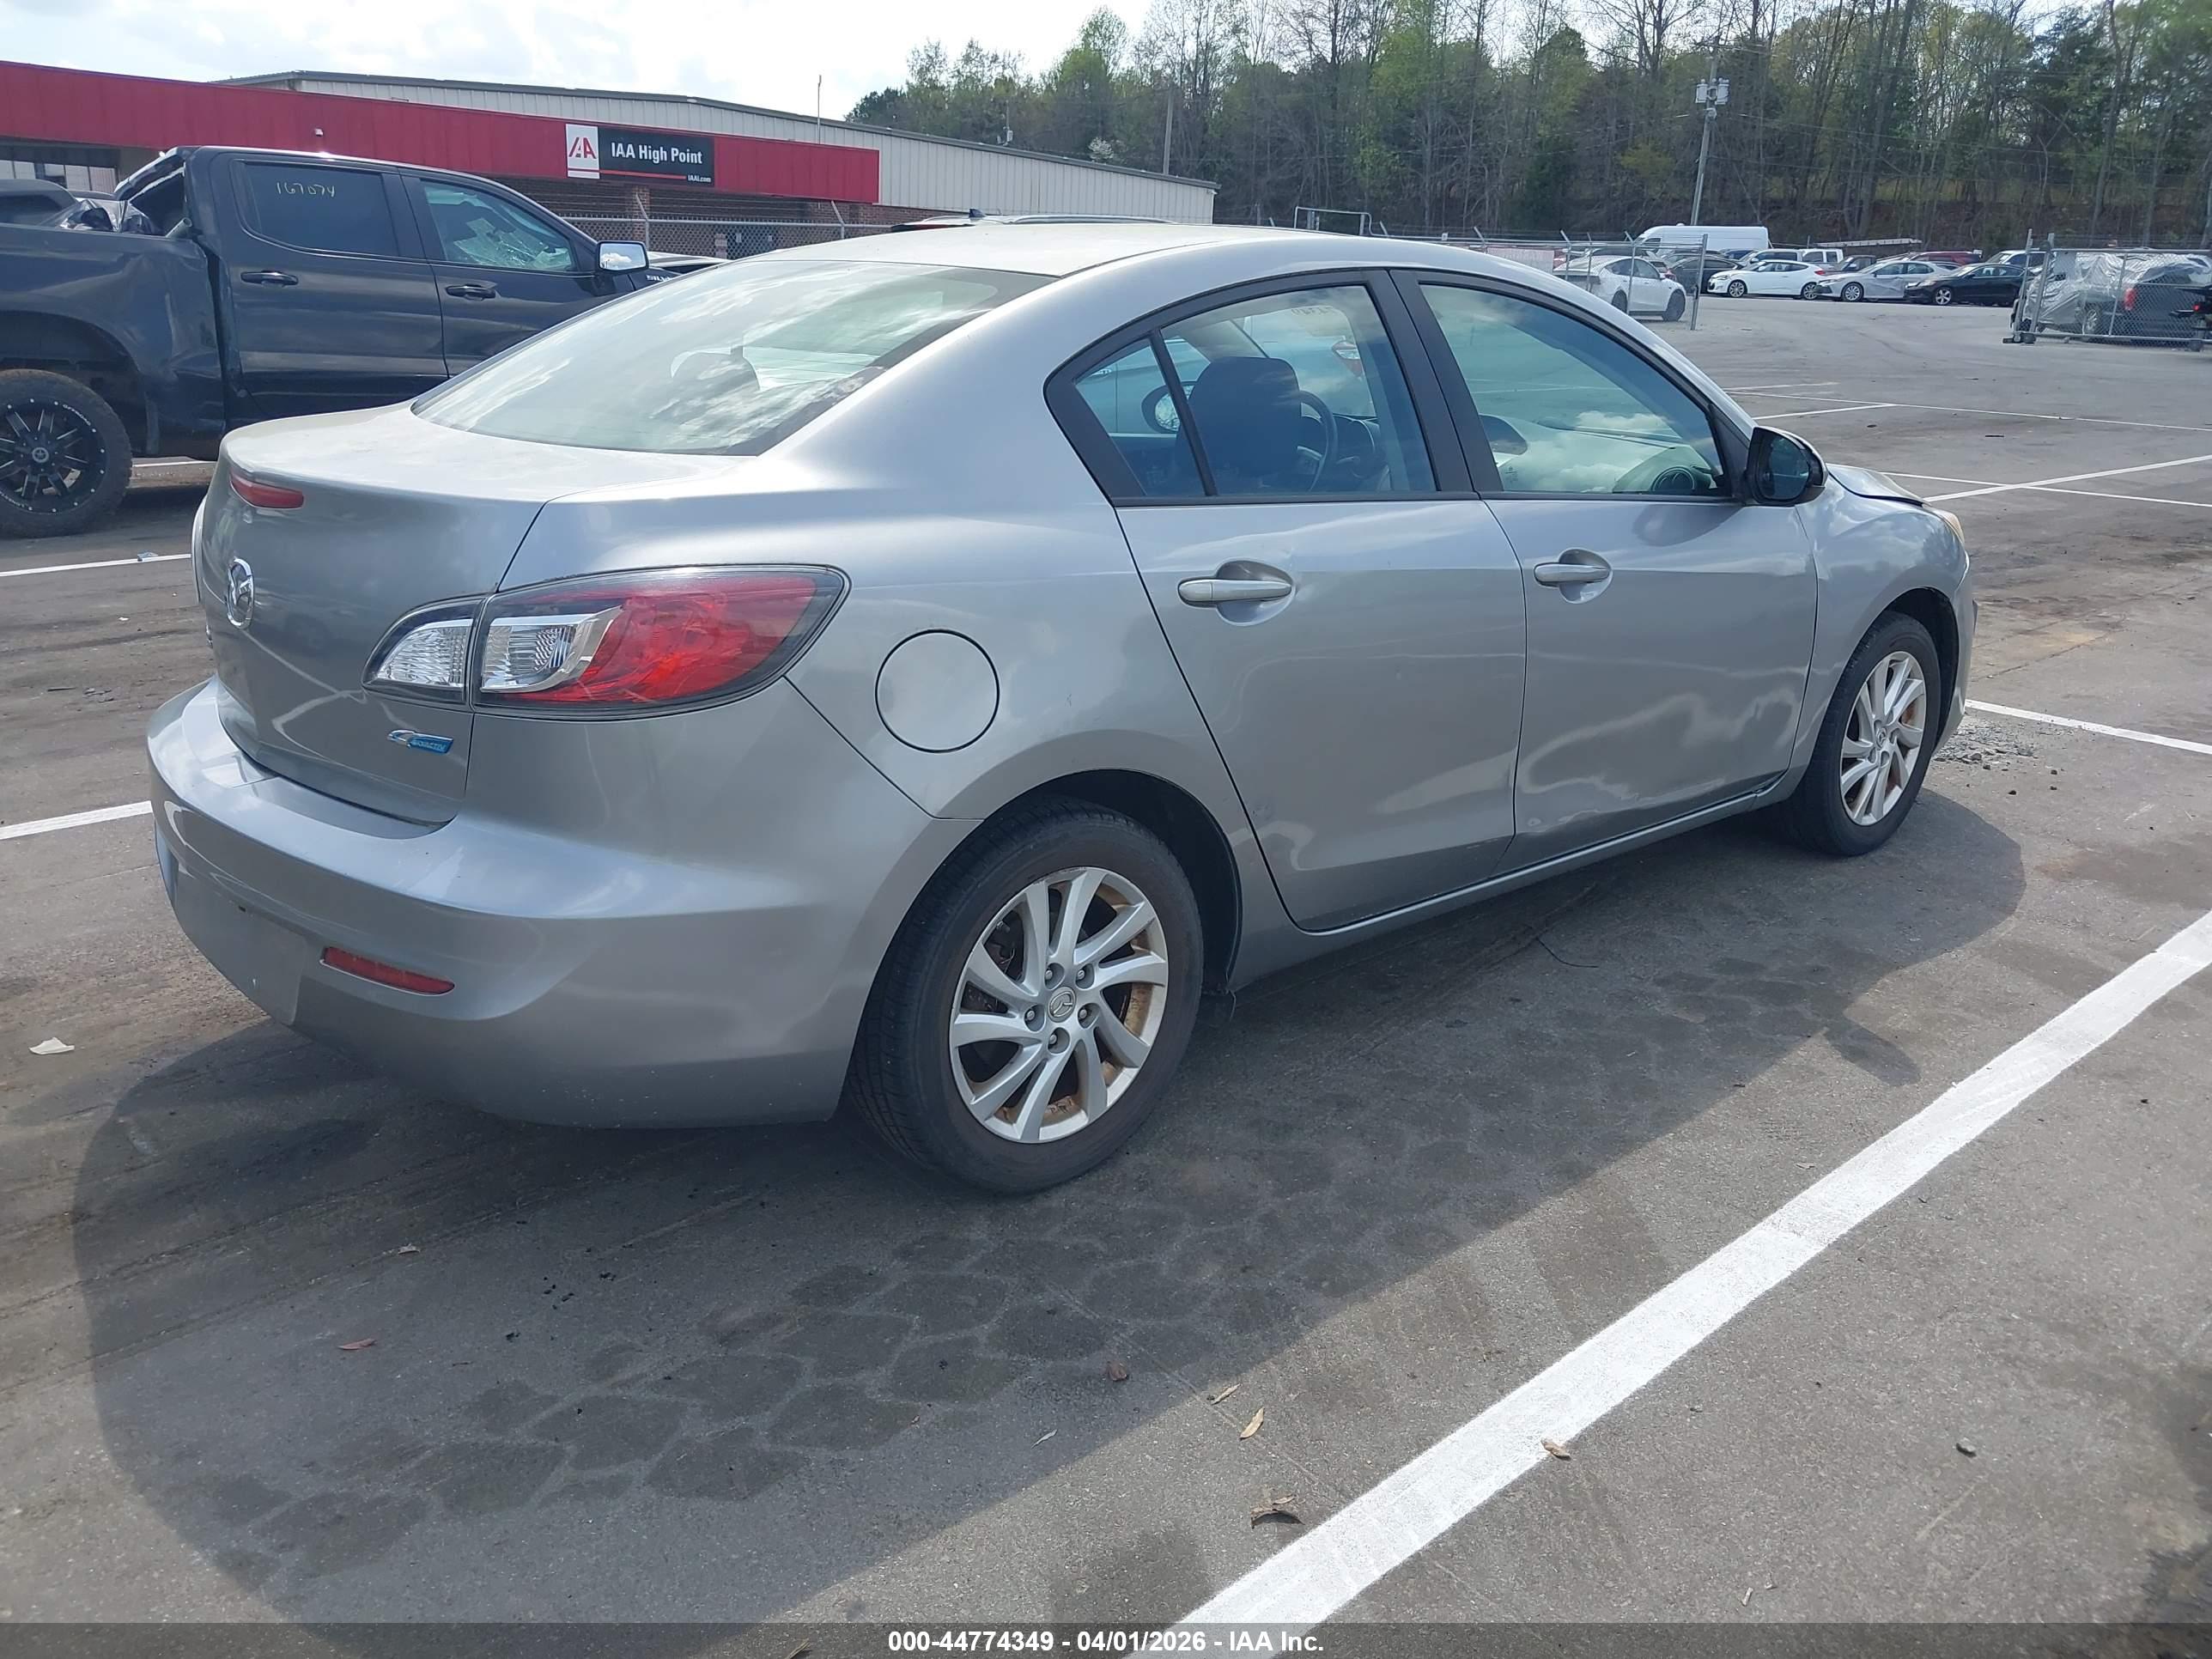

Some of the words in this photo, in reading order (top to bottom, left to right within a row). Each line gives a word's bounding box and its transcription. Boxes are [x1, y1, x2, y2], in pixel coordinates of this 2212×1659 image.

[611, 142, 635, 159] IAA
[639, 144, 668, 164] High
[671, 148, 702, 164] Point
